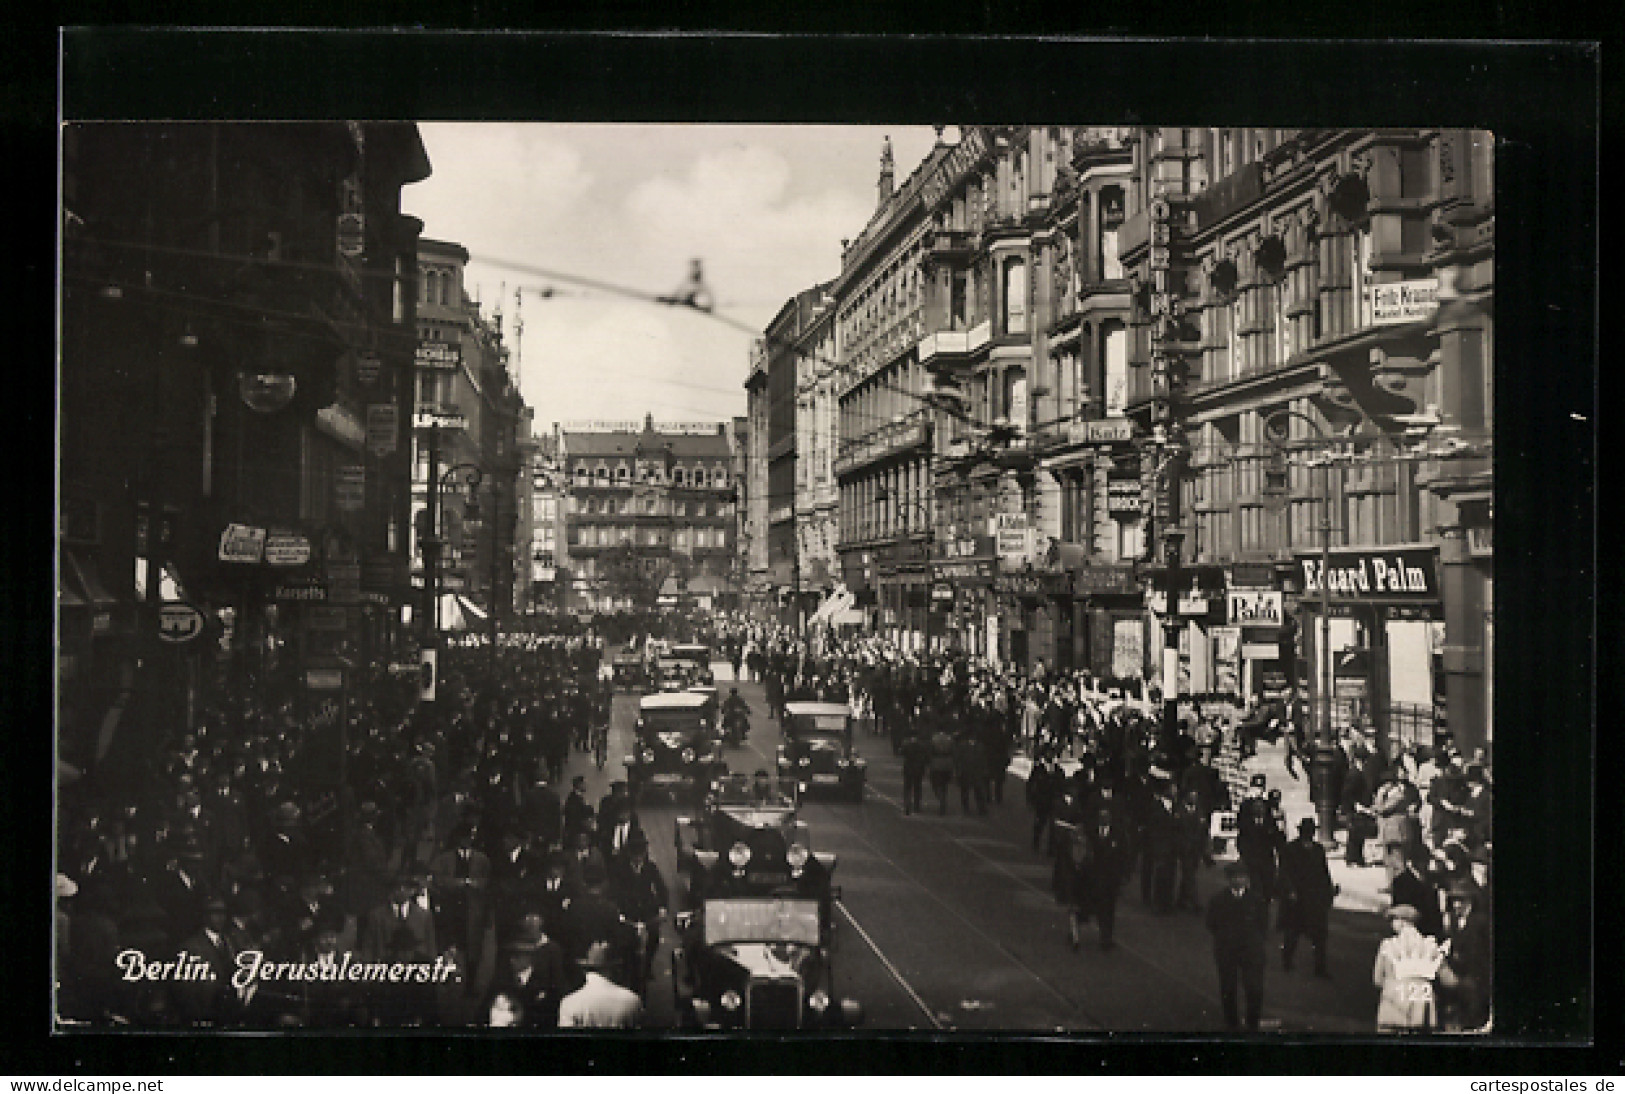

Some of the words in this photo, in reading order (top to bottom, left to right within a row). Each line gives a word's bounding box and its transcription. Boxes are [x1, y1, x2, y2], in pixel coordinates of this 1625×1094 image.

[1302, 557, 1370, 592] Eduard
[1372, 556, 1428, 592] Palm
[1232, 593, 1280, 622] Palm
